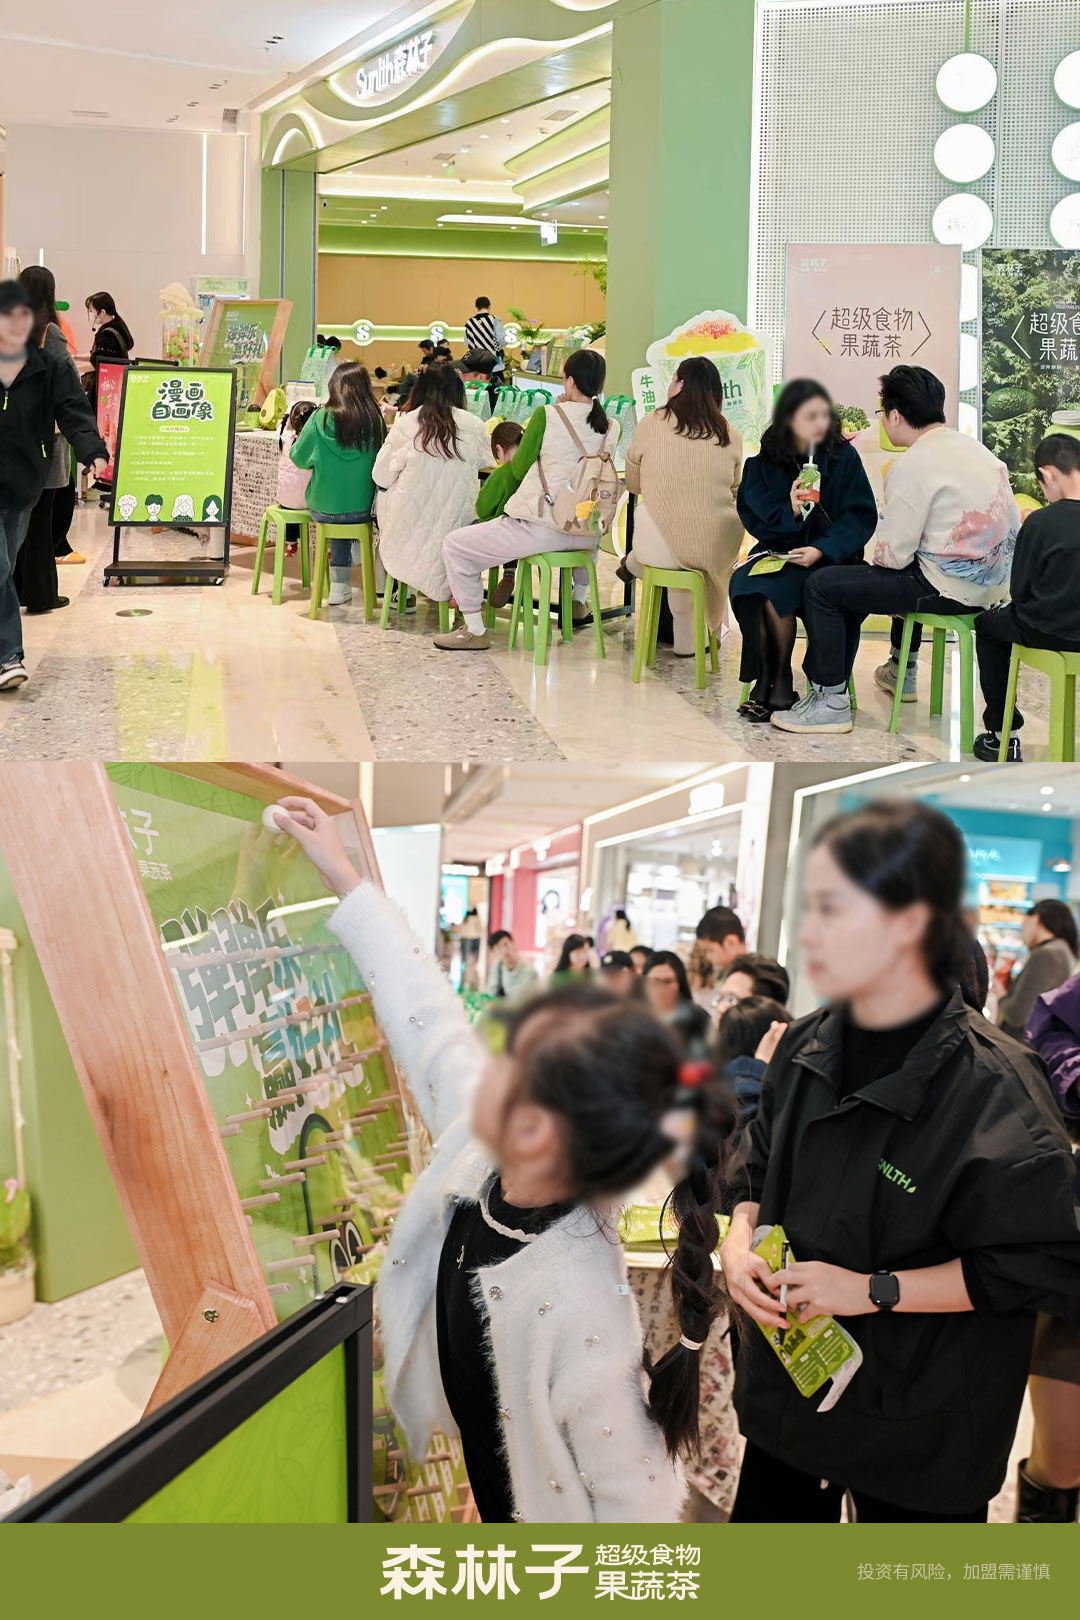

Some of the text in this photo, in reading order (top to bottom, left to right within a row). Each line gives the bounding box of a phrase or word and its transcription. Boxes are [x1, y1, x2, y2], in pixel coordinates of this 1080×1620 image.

[830, 306, 914, 331] 超级食物
[356, 325, 370, 339] S
[840, 333, 902, 358] 果蔬茶
[1040, 338, 1078, 360] 果蔬
[158, 379, 204, 402] 漫画
[722, 379, 743, 400] th
[151, 401, 213, 420] 自画像
[878, 1158, 912, 1190] NLTH
